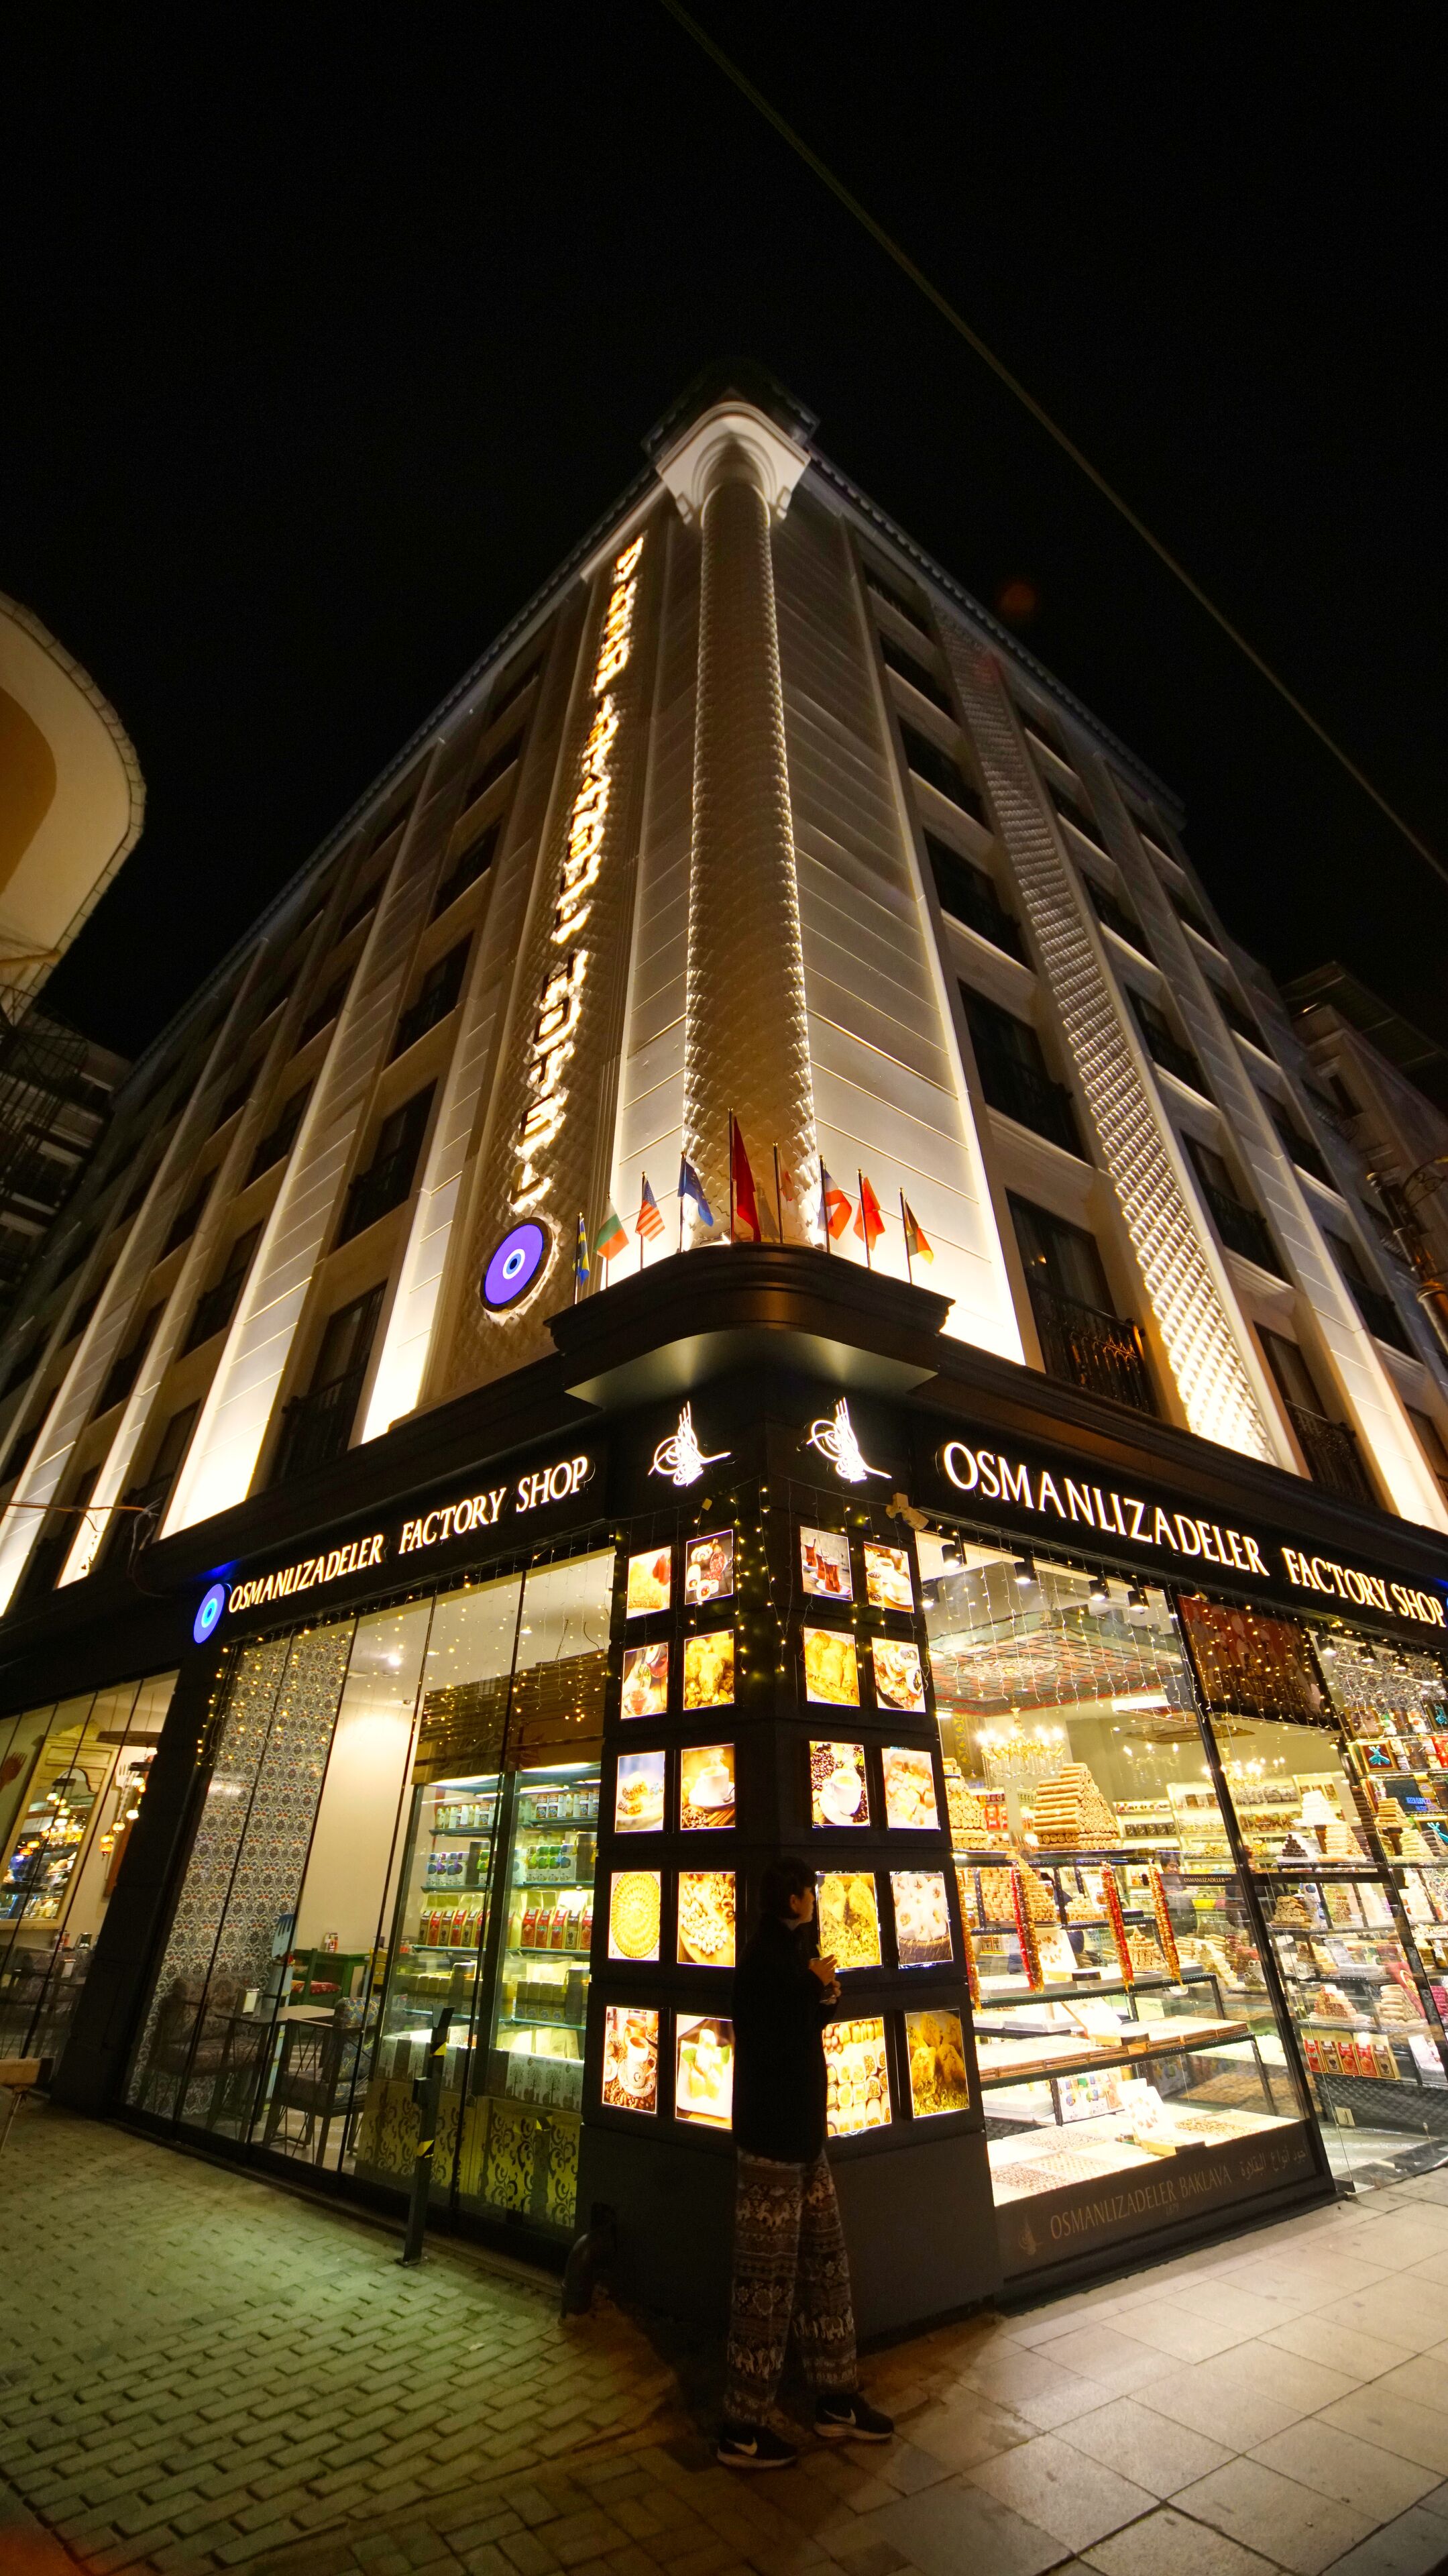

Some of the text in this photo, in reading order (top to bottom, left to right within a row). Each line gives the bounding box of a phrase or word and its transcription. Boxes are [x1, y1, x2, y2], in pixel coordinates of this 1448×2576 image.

[508, 949, 589, 1212] HOTEL
[228, 1456, 588, 1613] OSMANLIZADELER FACTORY SHOP
[943, 1442, 1447, 1628] OSMANLIZADELER FACTORY SHOP
[1050, 2165, 1233, 2240] OSMANLIZADELER BAKLAVA
